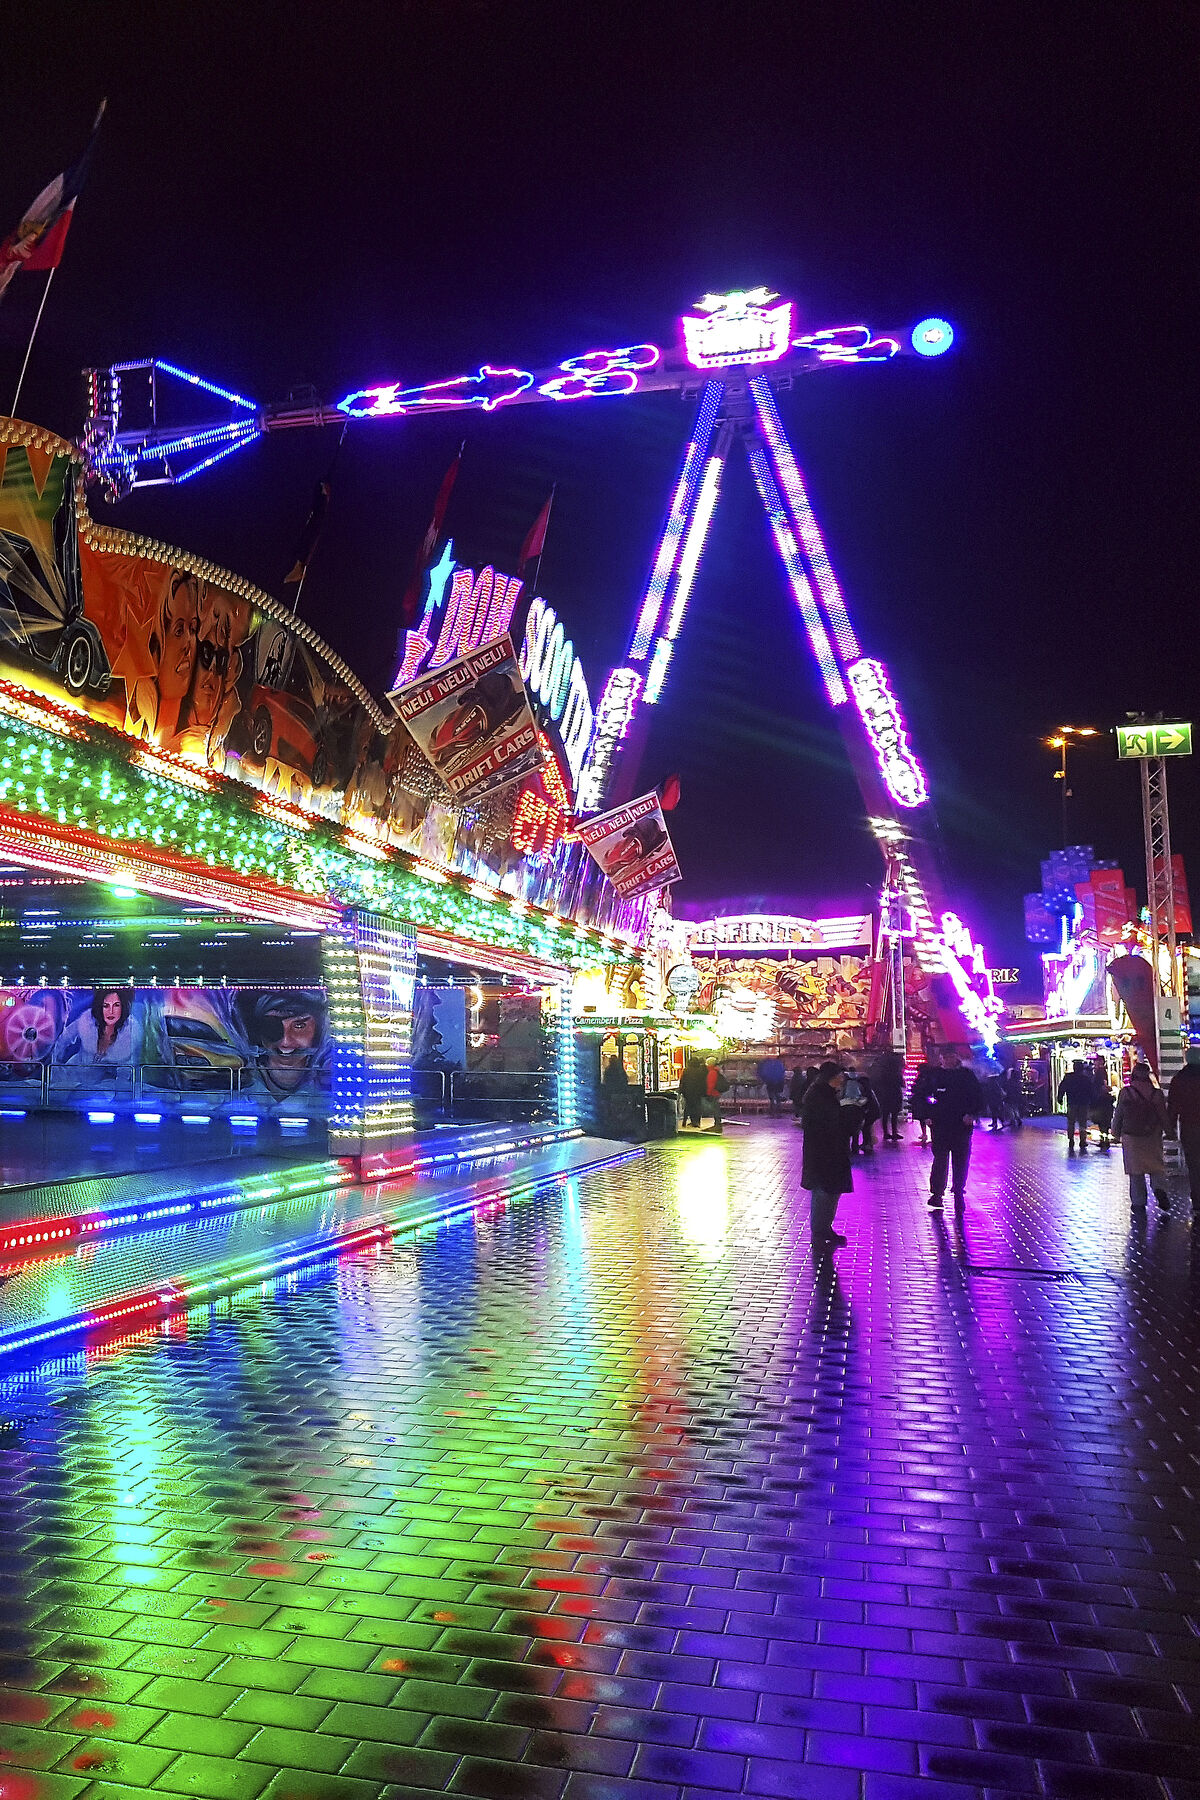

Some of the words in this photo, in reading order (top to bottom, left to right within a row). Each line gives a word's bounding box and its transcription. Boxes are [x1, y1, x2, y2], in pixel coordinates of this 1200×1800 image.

[400, 690, 433, 717] NEU!
[437, 667, 471, 695] NEU!
[472, 646, 507, 673] NEU!
[451, 760, 494, 792] DRIFT
[493, 728, 535, 762] CARS
[584, 827, 606, 843] NEU!
[608, 814, 631, 830] NEU!
[632, 800, 654, 817] NEU!
[617, 871, 647, 892] DRIFT
[646, 854, 674, 876] CARS
[696, 921, 815, 944] INFINITY
[574, 1015, 616, 1025] Camembert
[624, 1015, 644, 1025] Pizza
[1164, 1008, 1172, 1020] 4
